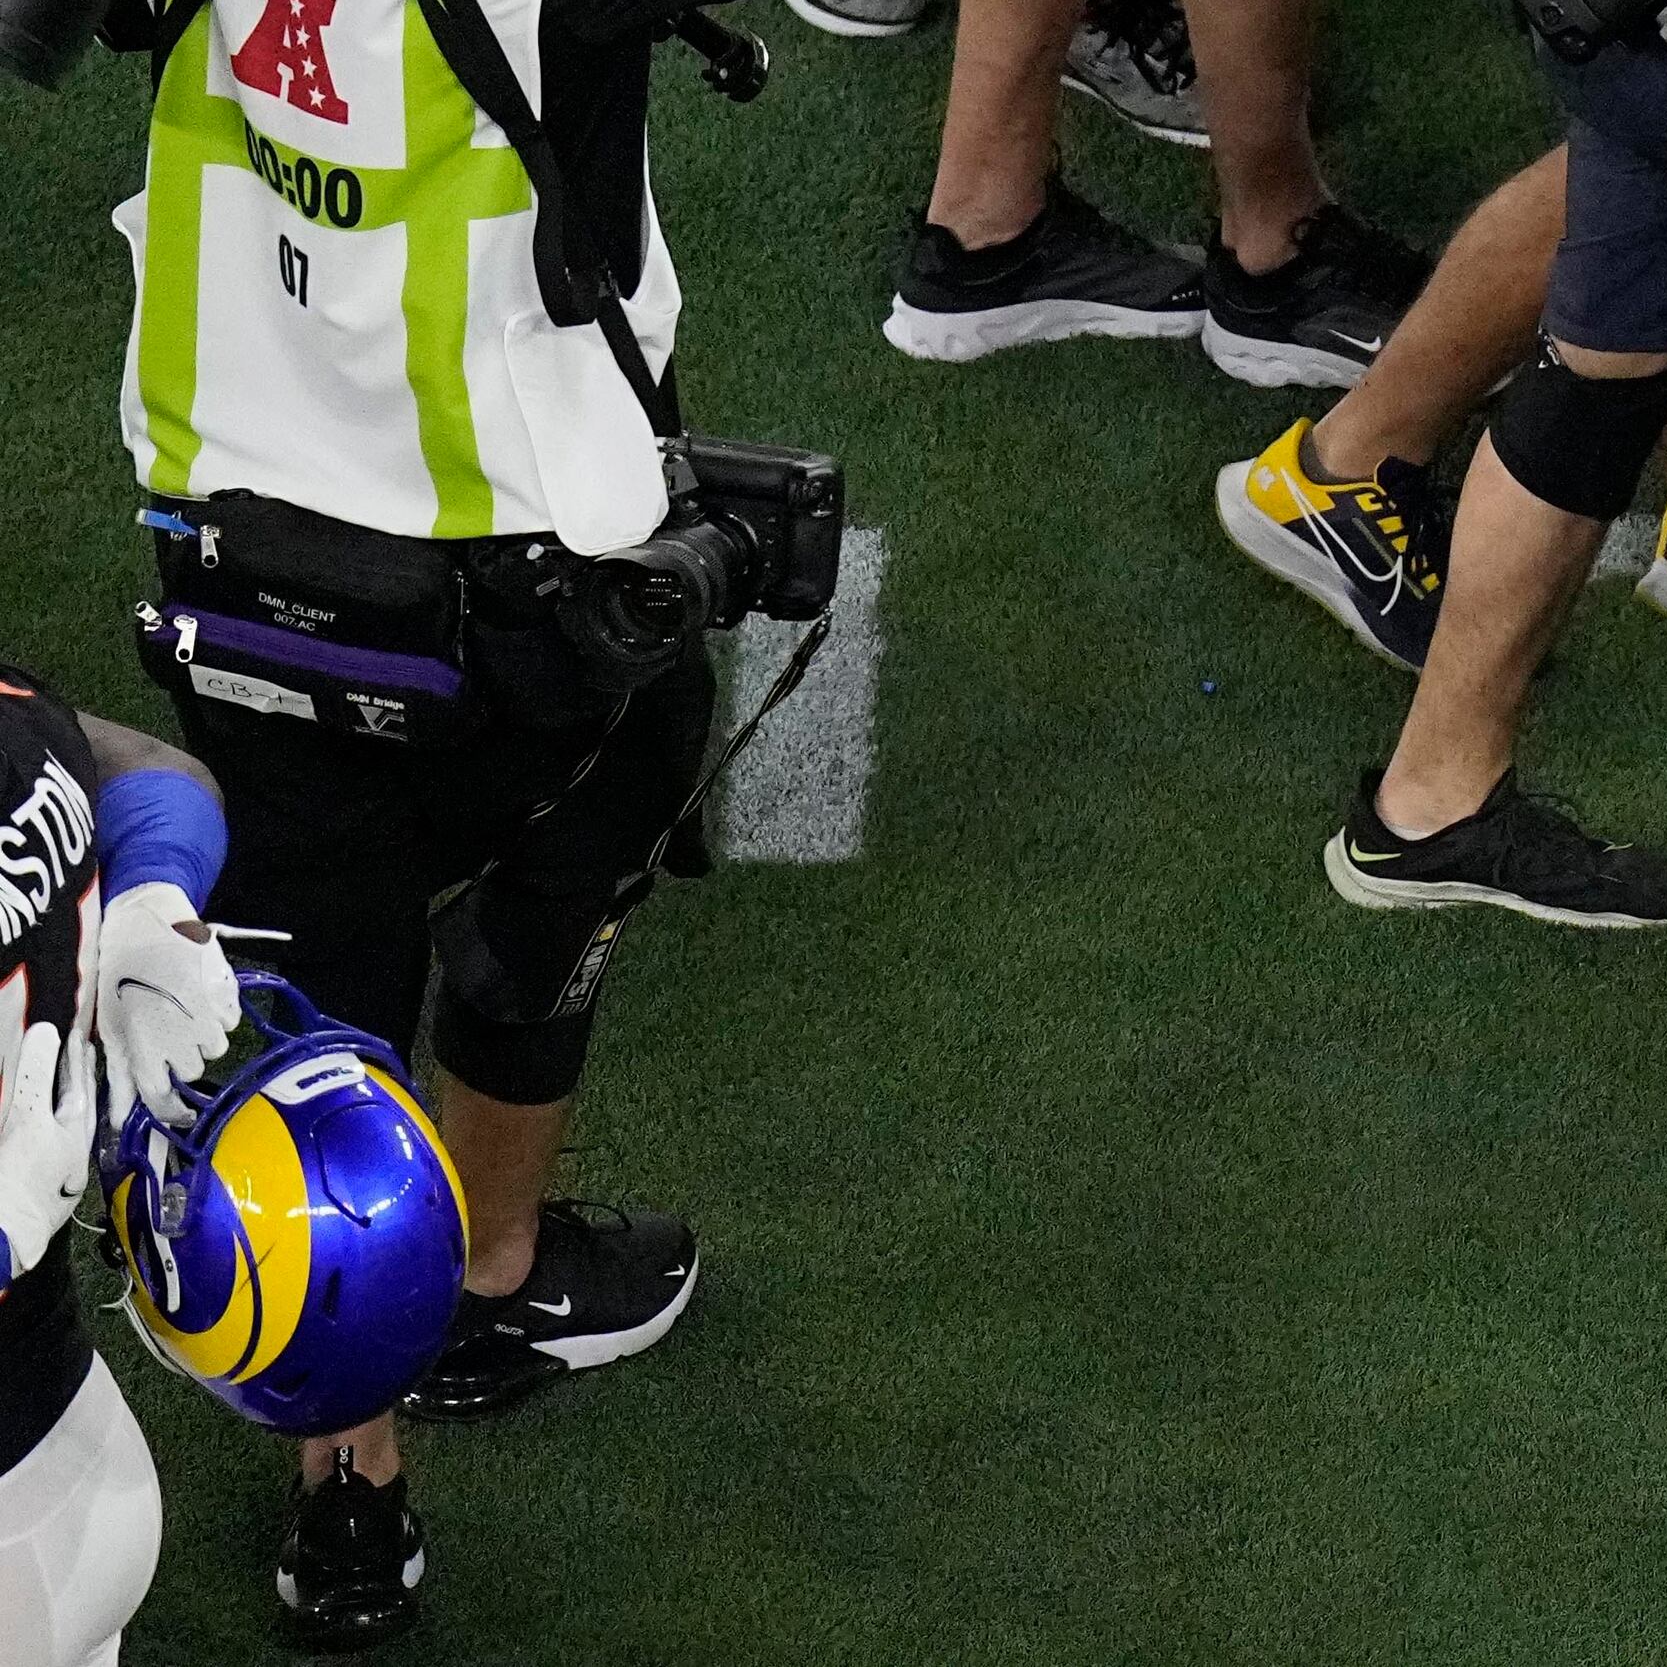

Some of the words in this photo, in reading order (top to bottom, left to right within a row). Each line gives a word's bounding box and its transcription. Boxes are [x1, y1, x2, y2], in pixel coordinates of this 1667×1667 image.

[246, 118, 364, 230] 00:00
[278, 233, 310, 309] 07
[257, 591, 337, 623] DMN_CLIENT
